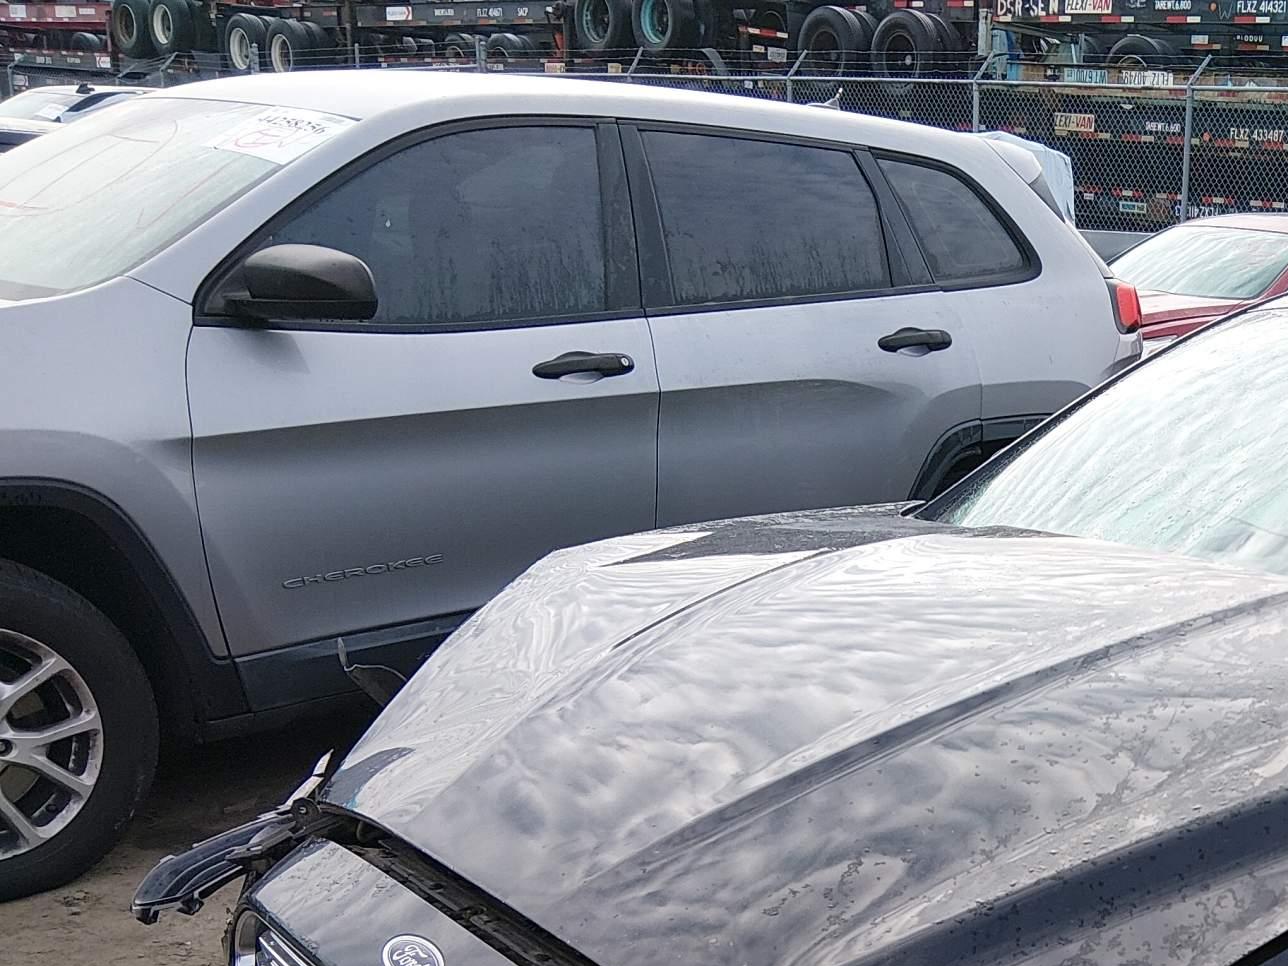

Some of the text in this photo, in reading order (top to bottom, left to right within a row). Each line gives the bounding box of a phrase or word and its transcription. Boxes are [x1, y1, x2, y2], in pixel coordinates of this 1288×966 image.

[1237, 1, 1287, 13] FLXZ 414321
[1230, 128, 1284, 142] FLXZ 433487
[282, 553, 444, 590] CHEROKEE
